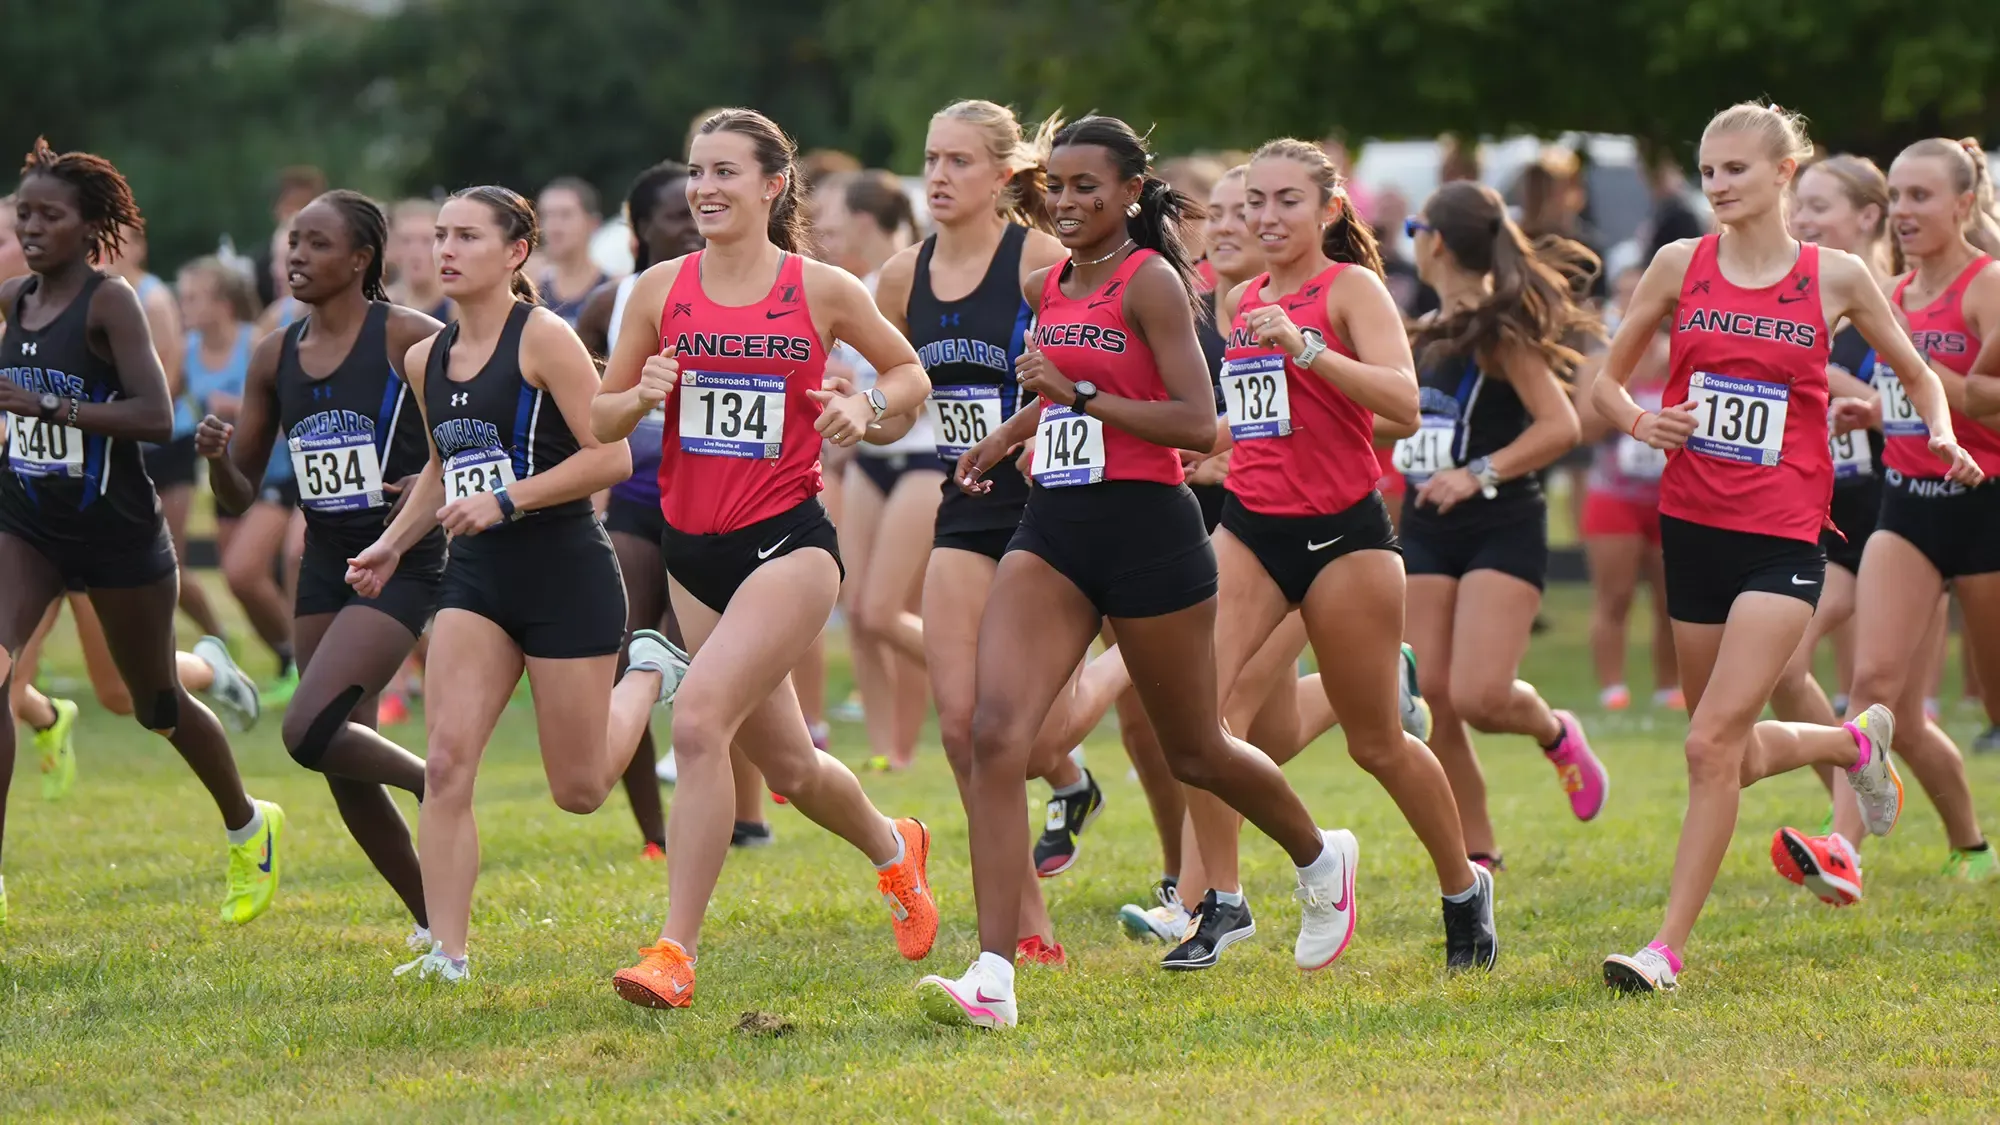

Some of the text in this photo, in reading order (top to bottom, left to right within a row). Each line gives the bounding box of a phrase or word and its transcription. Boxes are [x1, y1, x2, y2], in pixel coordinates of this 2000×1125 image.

[1679, 308, 1816, 348] LANCERS
[918, 338, 1008, 371] OUGARS
[1261, 358, 1283, 368] Timing
[697, 375, 784, 390] Crossroads Timing
[969, 387, 999, 397] Timing
[1234, 374, 1278, 420] 132
[1704, 376, 1788, 399] Crossroads Timing
[1887, 381, 1912, 418] 13
[700, 391, 767, 440] 134
[937, 402, 988, 444] 536
[1705, 394, 1769, 445] 130
[16, 415, 67, 460] 540
[300, 432, 372, 448] Crossroads Timing
[1045, 419, 1090, 469] 142
[304, 449, 365, 496] 534
[1909, 478, 1967, 497] NIKE
